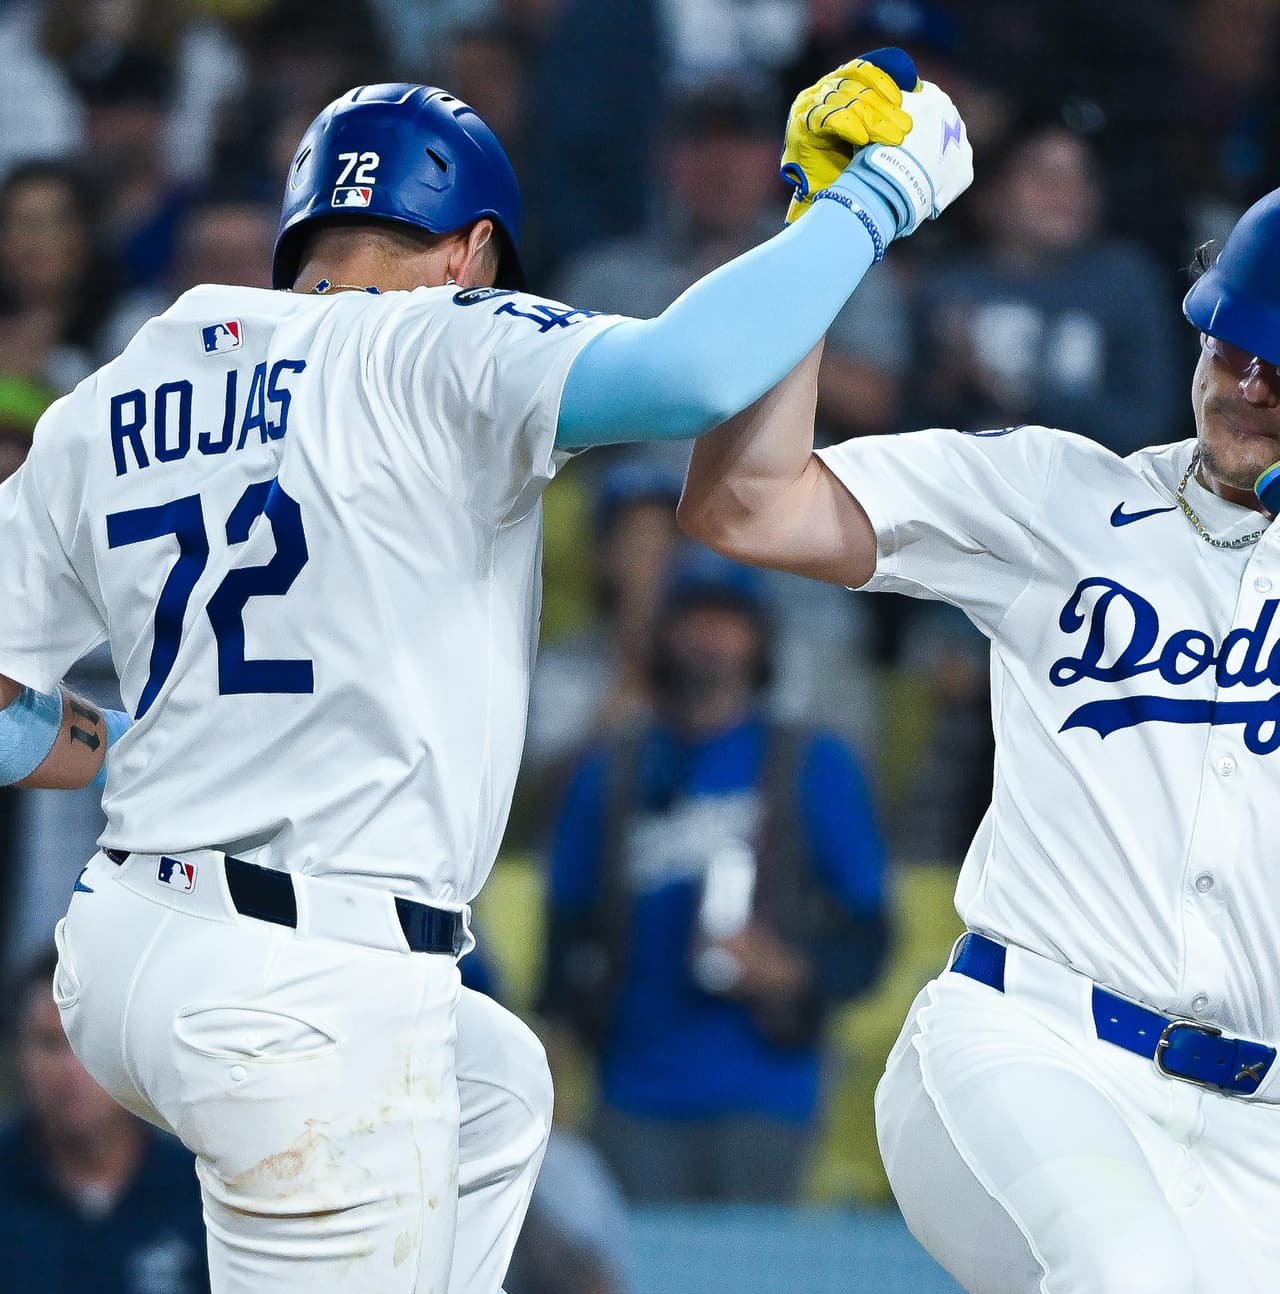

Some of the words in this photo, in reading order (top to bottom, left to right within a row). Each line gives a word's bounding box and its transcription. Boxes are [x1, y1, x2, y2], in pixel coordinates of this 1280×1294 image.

[335, 151, 380, 186] 72
[110, 360, 307, 477] ROJAS
[106, 474, 315, 721] 72
